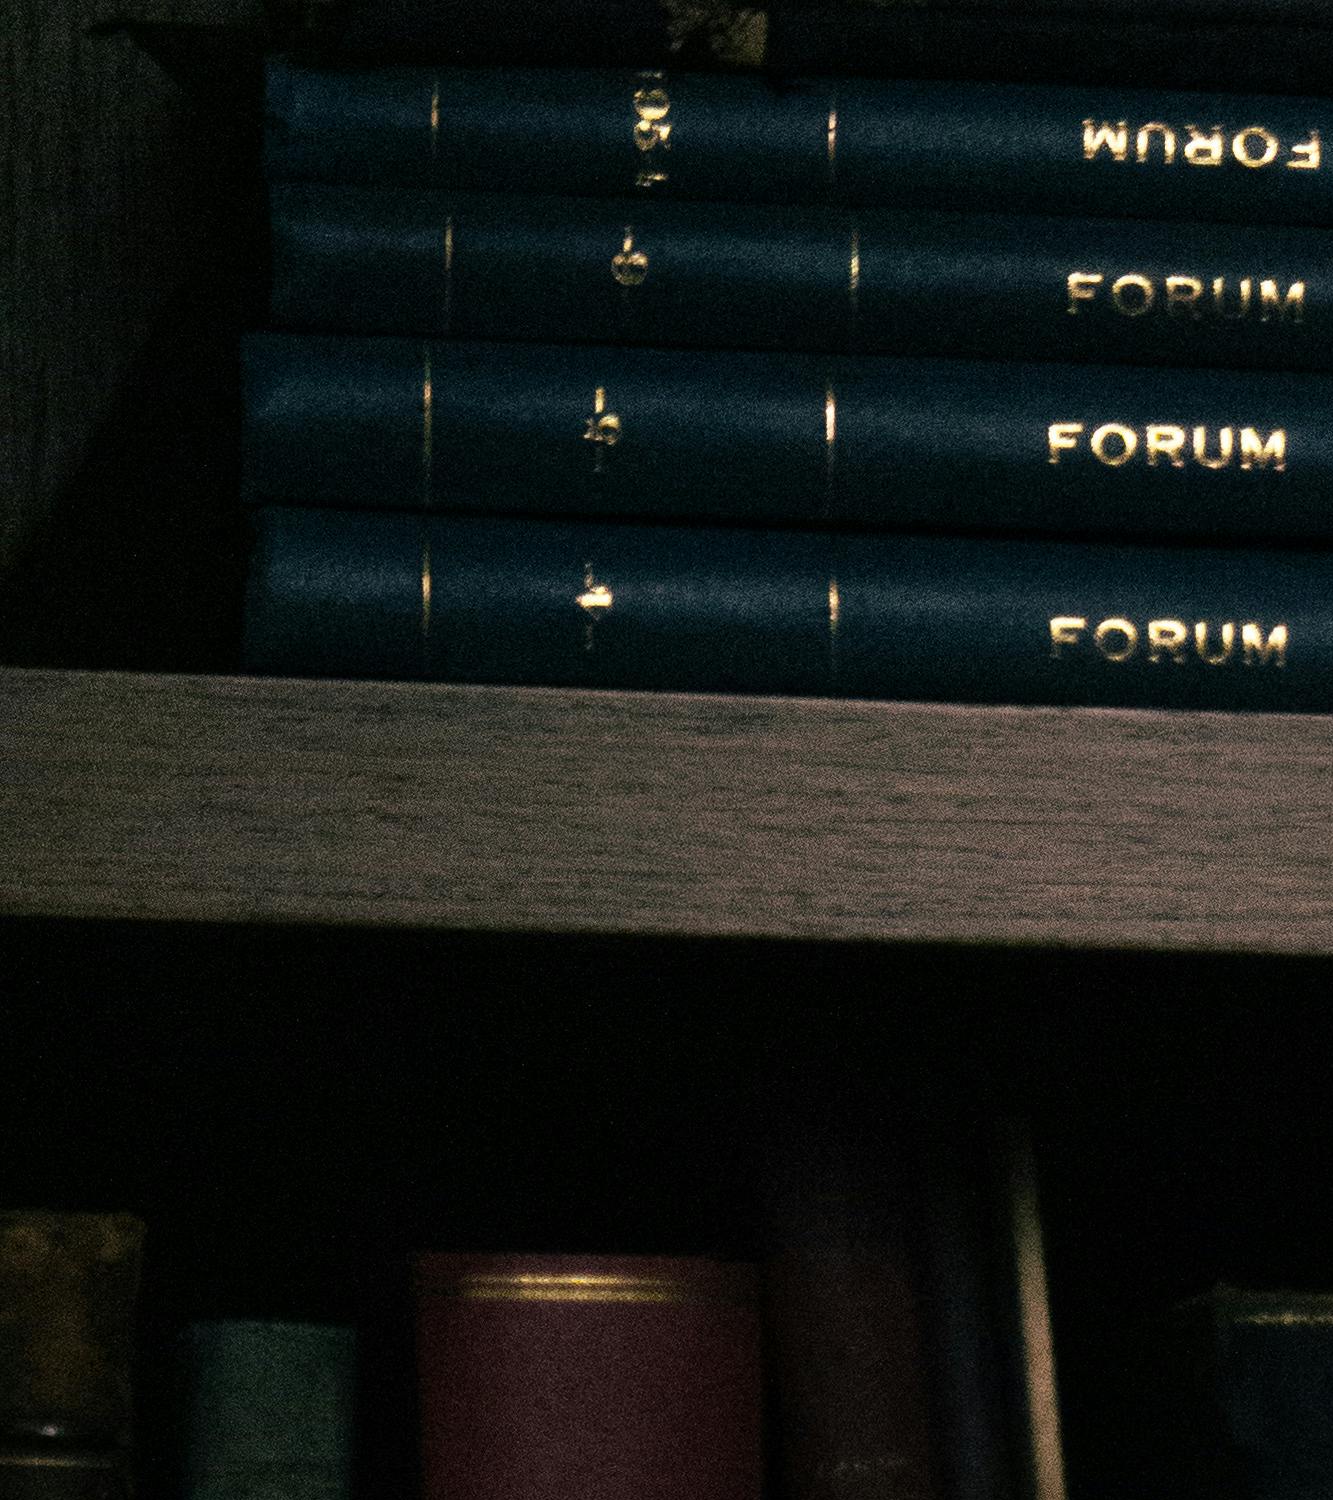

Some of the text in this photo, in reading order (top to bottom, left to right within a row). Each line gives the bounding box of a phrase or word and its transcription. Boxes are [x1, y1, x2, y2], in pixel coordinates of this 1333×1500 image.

[1082, 118, 1322, 170] FORUM
[1066, 271, 1306, 324] FORUM
[1047, 422, 1286, 472] FORUM
[1049, 615, 1288, 668] FORUM
